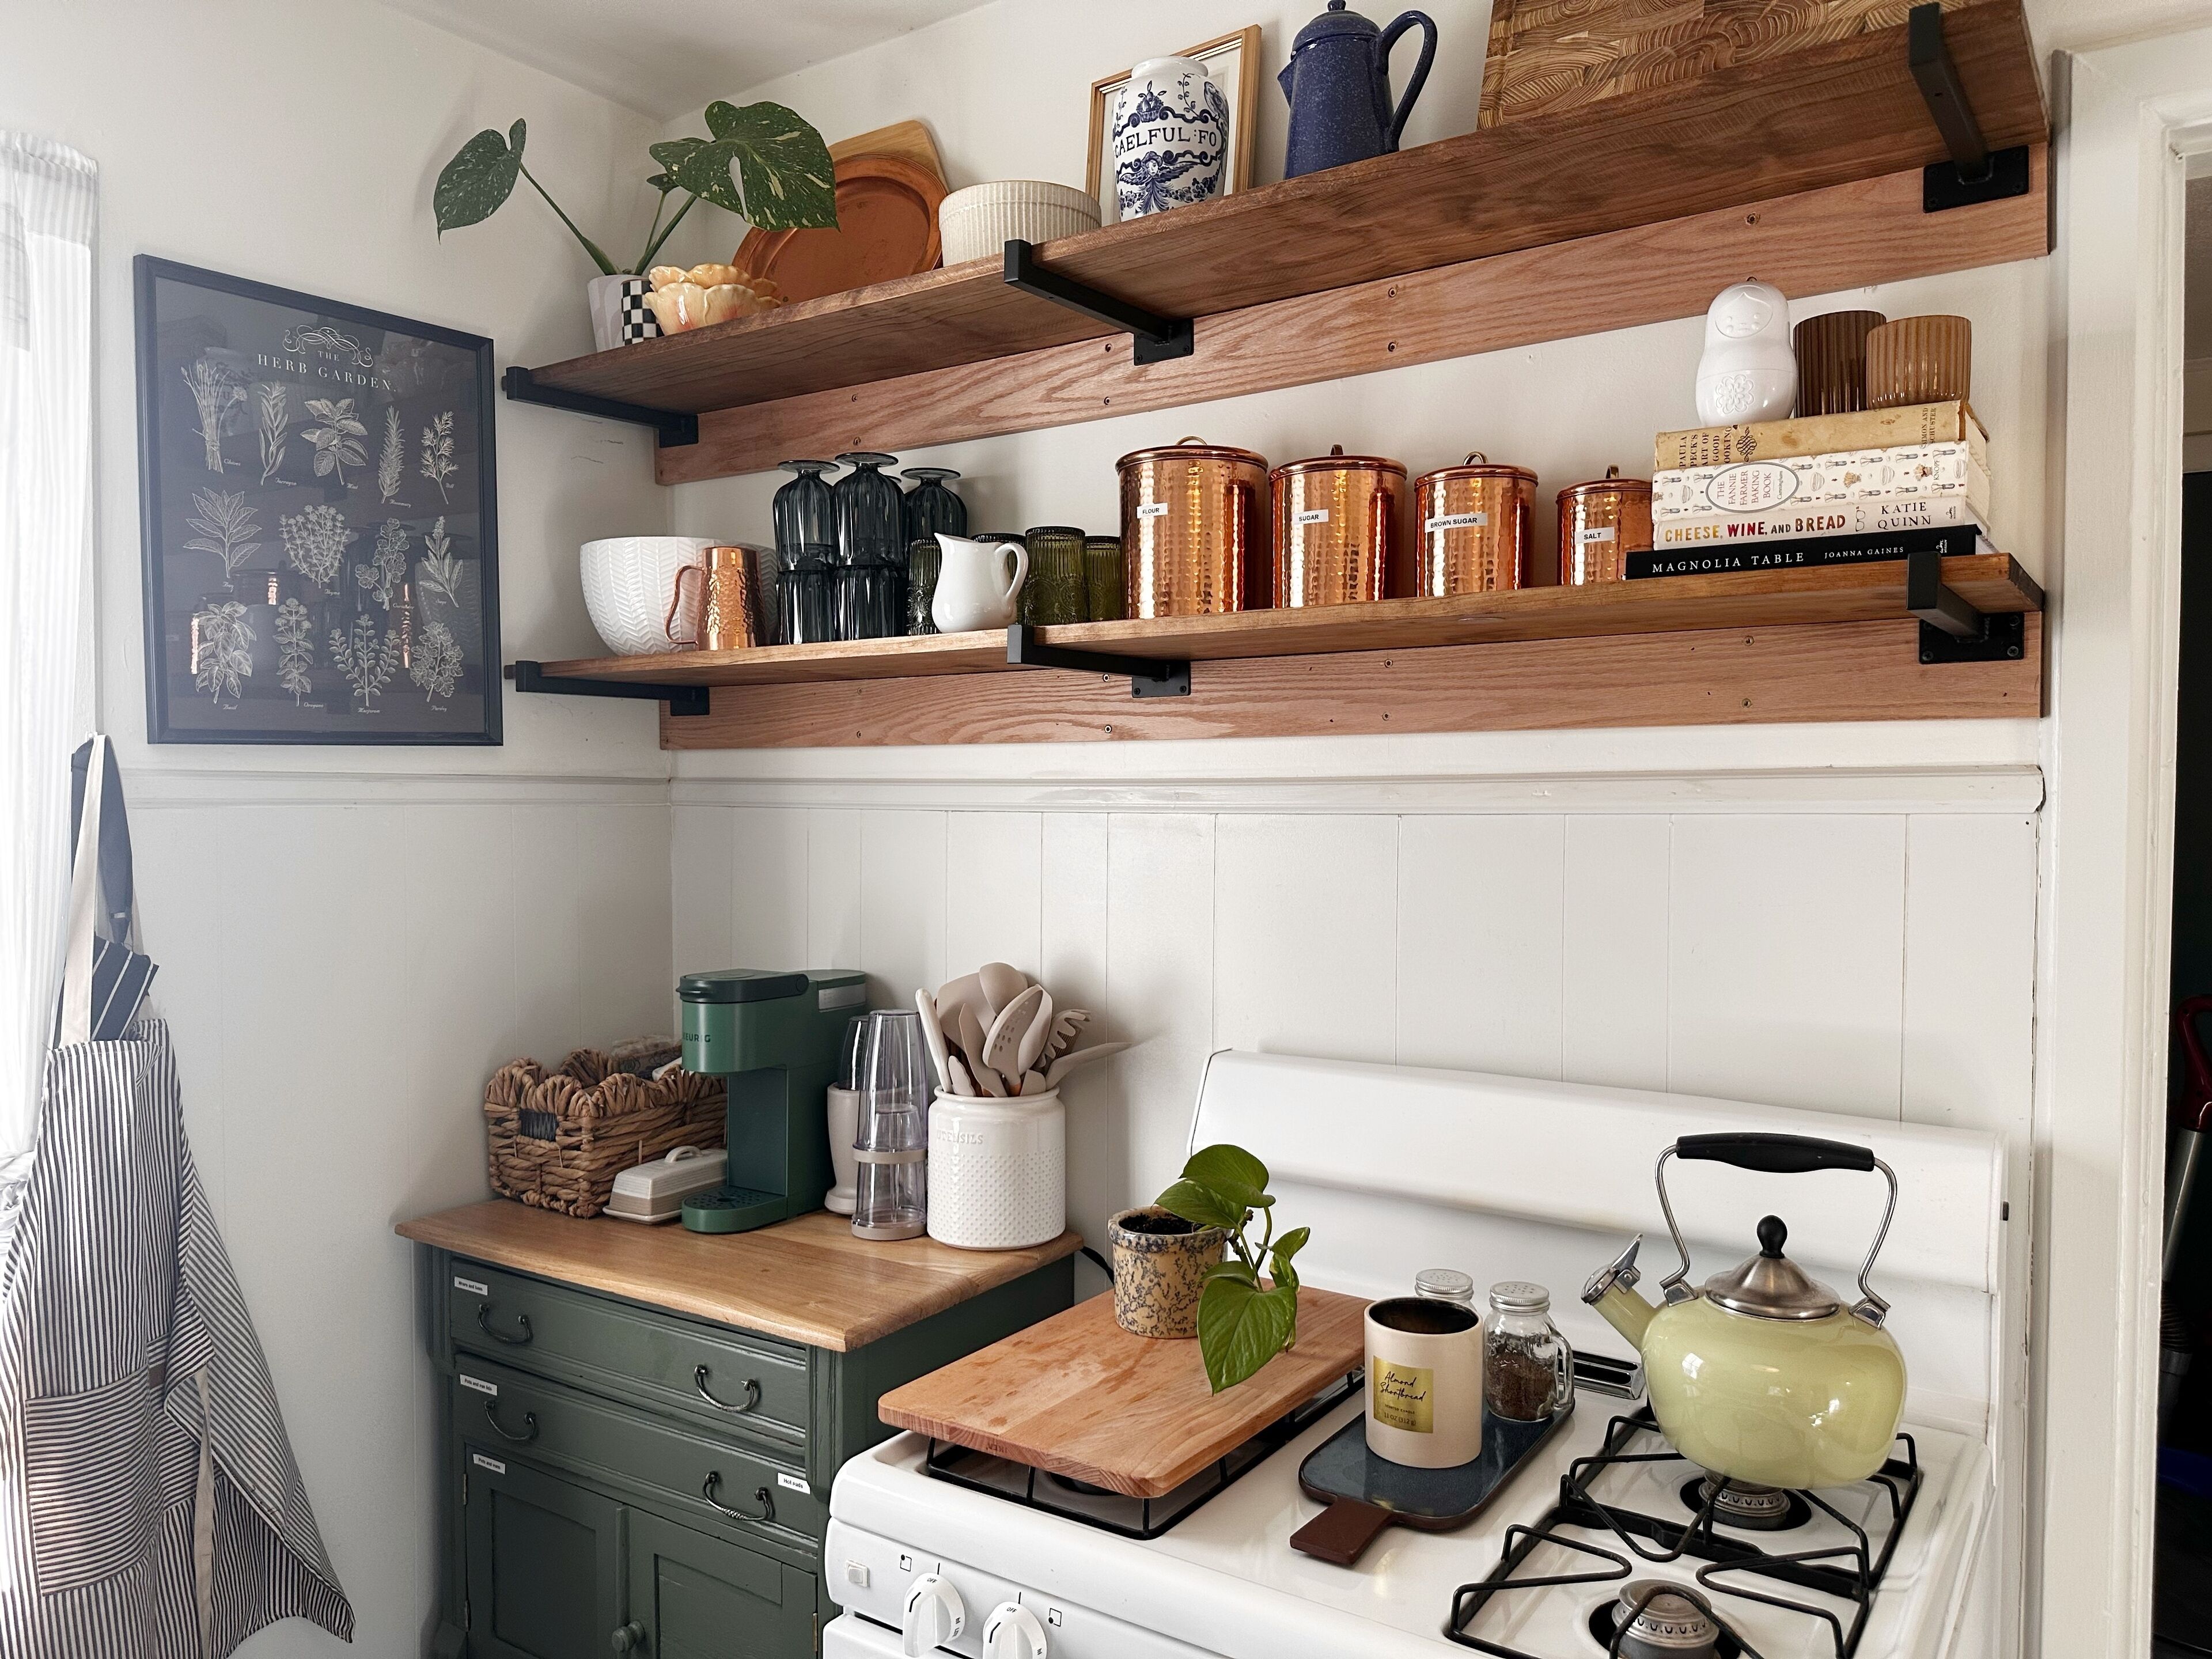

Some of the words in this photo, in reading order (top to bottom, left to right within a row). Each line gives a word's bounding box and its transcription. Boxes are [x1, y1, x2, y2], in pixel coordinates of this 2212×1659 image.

[317, 350, 340, 361] THE
[257, 353, 307, 374] HERB
[318, 366, 396, 392] GARDEN.
[1702, 432, 1709, 444] OF
[1724, 426, 1732, 464] OOKING
[1679, 436, 1687, 468] PAULA
[1690, 434, 1698, 467] PECK'S
[1728, 473, 1736, 505] FANNIE
[1740, 470, 1748, 505] FARMER
[1752, 470, 1760, 503] BAKING
[1763, 472, 1771, 498] BOOK
[1881, 501, 1927, 514] KATIE
[1430, 520, 1451, 528] BROWN
[1727, 521, 1767, 537] WINE,
[1771, 524, 1791, 535] AND
[1795, 514, 1846, 532] BREAD
[1877, 515, 1931, 530] QUINN
[1652, 556, 1741, 573] MAGNOLIA
[1751, 552, 1804, 565] TABLE
[1824, 550, 1862, 559] JOANNA
[1867, 547, 1904, 555] GAINES
[683, 1032, 711, 1043] EURG
[937, 1129, 983, 1145] UTENSILS
[1384, 1371, 1417, 1388] Almond
[1380, 1382, 1426, 1402] Shortbread
